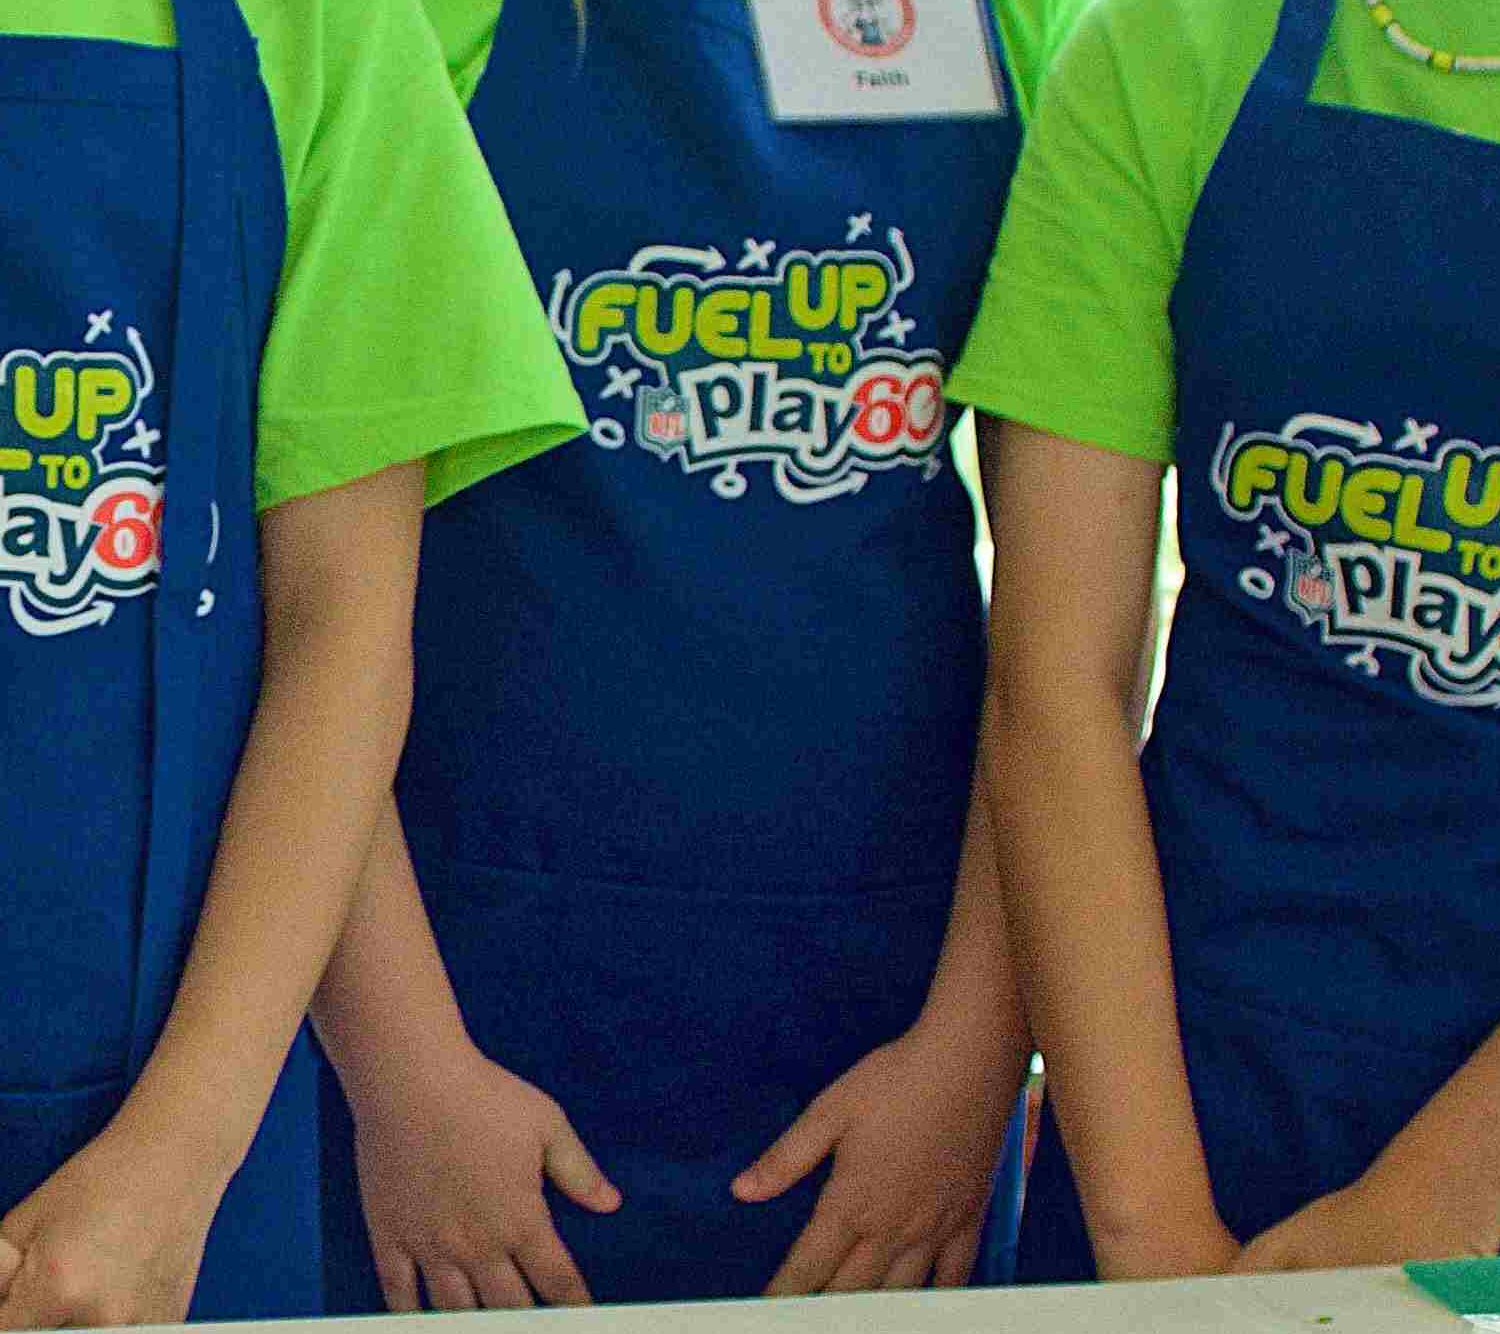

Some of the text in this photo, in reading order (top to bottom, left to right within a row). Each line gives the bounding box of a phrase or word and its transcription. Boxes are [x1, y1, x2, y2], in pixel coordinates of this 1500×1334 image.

[855, 69, 910, 87] Faith
[577, 264, 889, 360] FUEL UP
[808, 341, 852, 375] TO
[13, 365, 132, 440] UP
[851, 374, 942, 445] 60
[39, 454, 92, 489] TO
[1232, 443, 1452, 553] FUEL
[94, 491, 163, 569] 6
